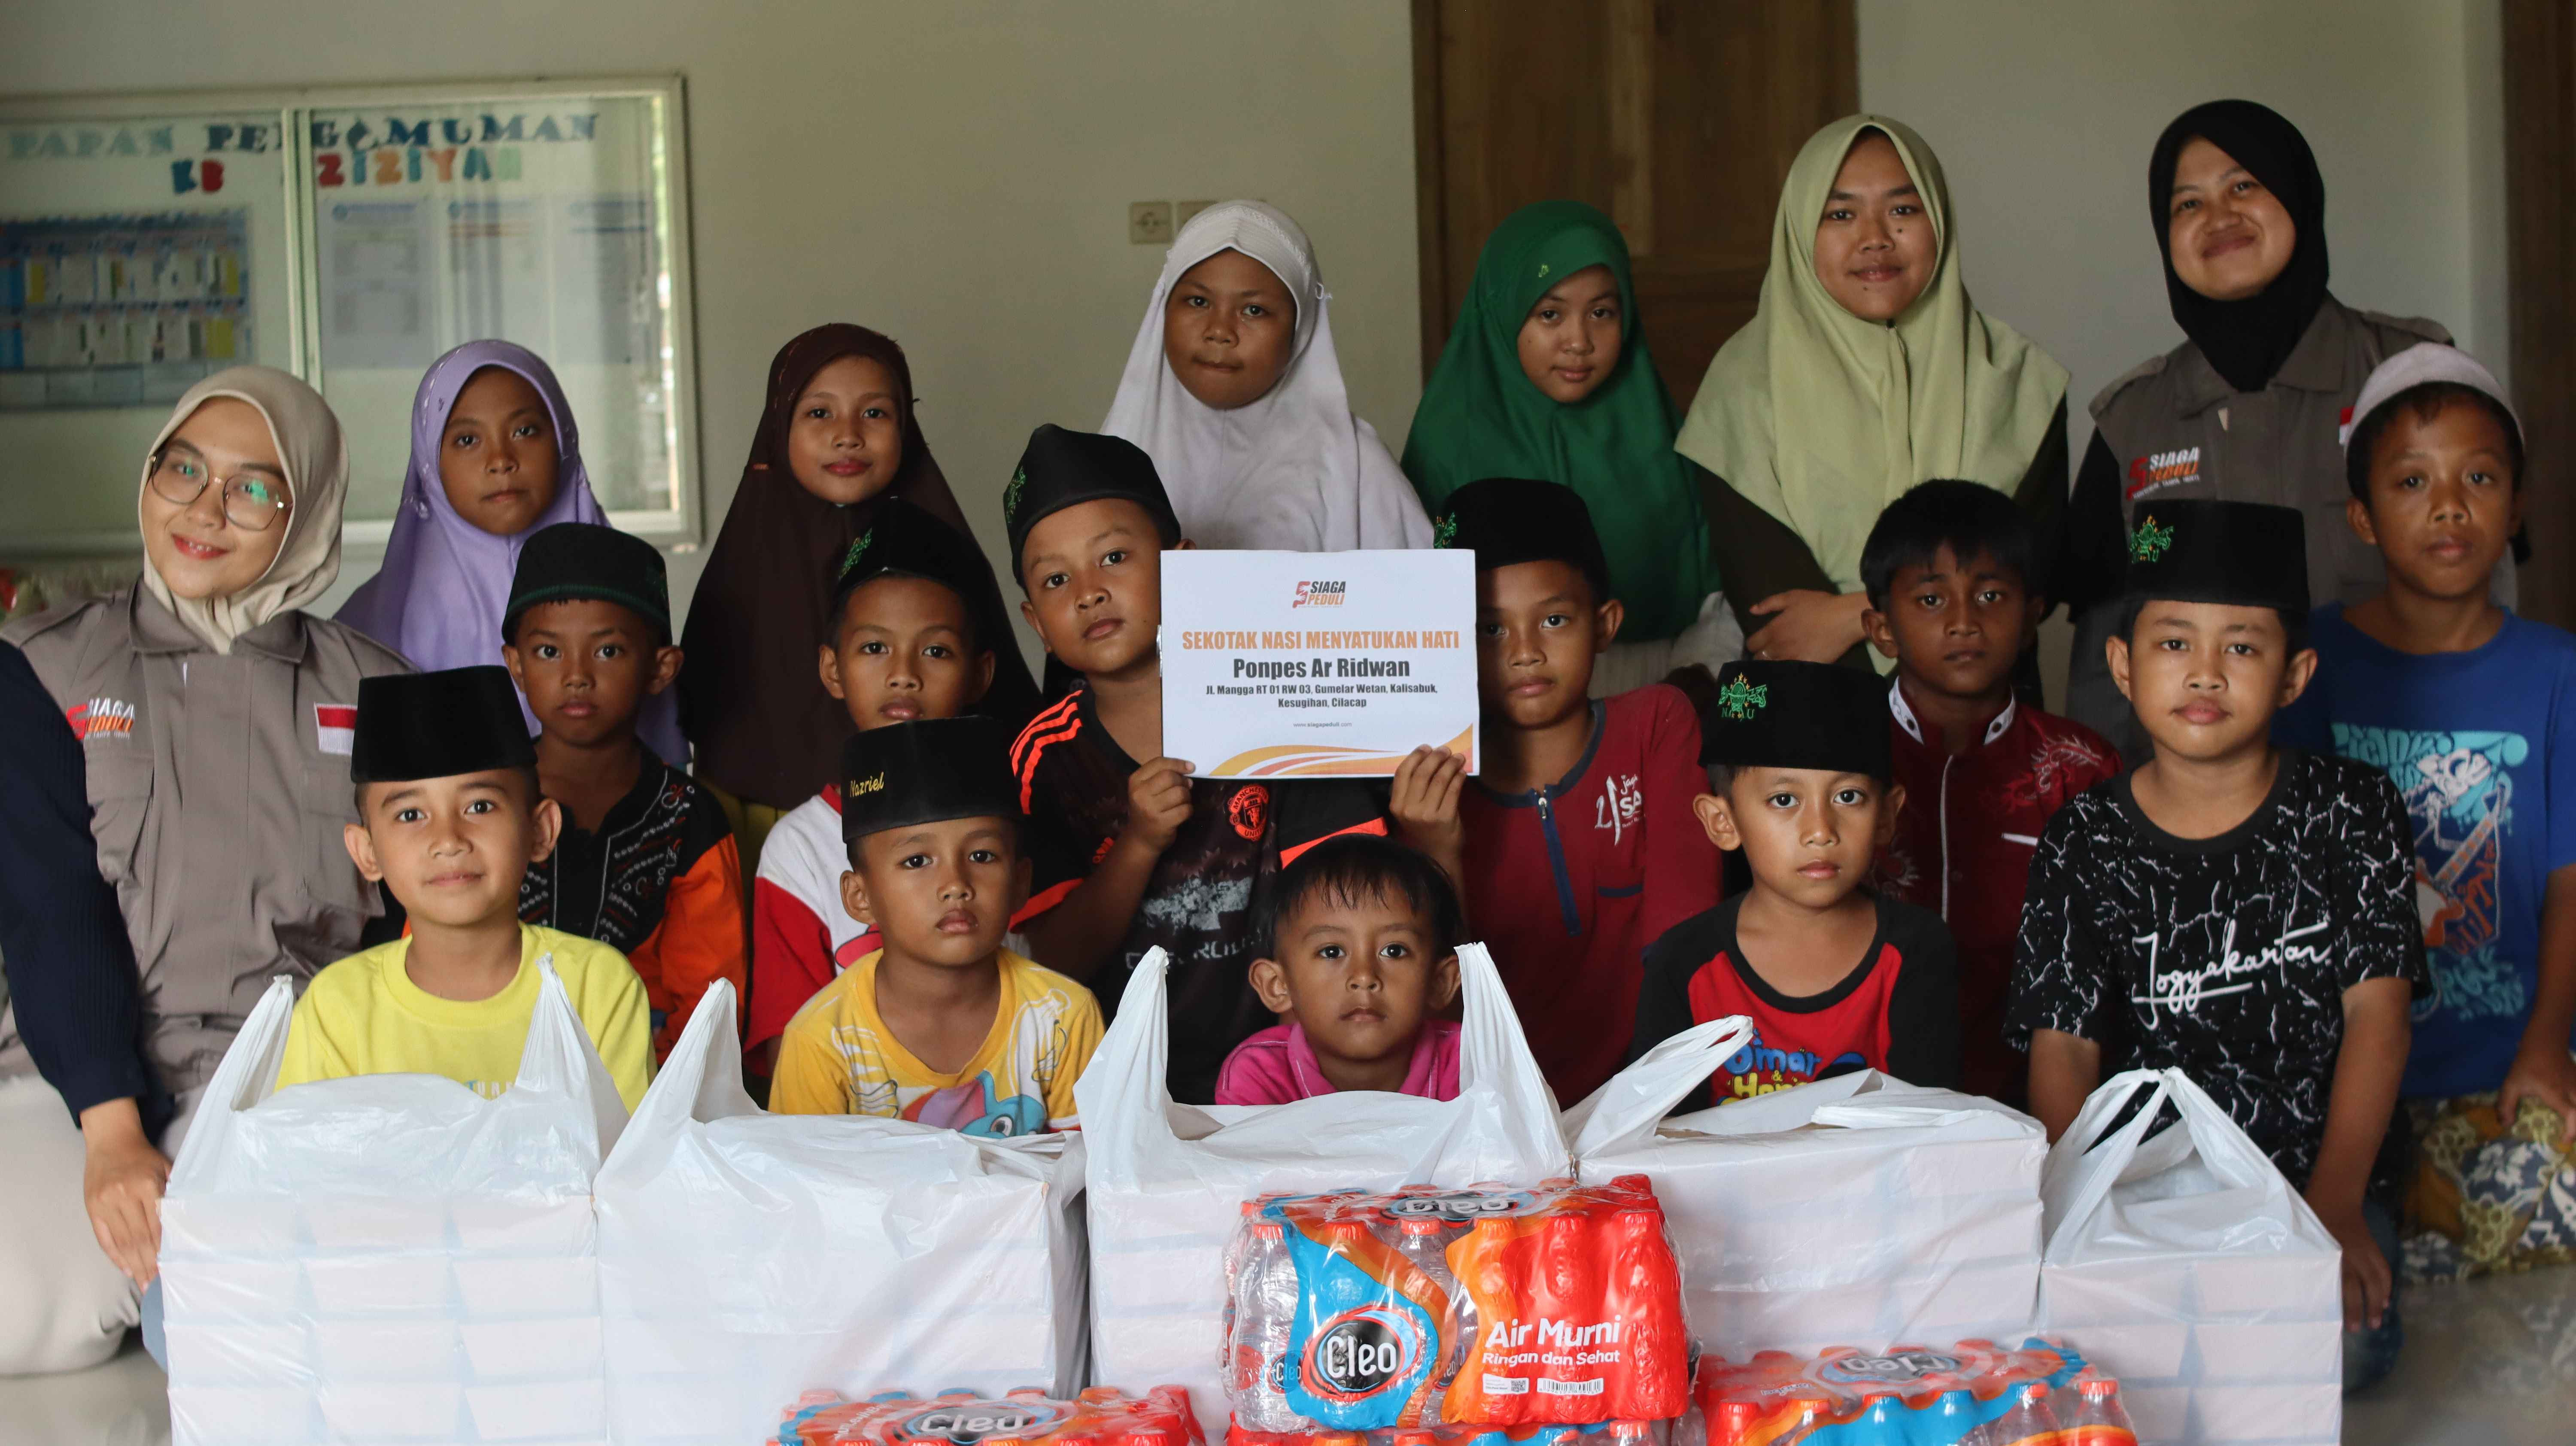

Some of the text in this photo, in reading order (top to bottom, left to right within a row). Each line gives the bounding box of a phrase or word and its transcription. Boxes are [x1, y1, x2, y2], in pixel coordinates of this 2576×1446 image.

[9, 125, 175, 158] PAPAN
[171, 158, 225, 195] KB
[2149, 446, 2200, 470] SIAGA
[1310, 581, 1346, 593] SIAGA
[1307, 594, 1345, 605] PEDULI
[1182, 631, 1459, 650] SEKOTAK NASI MENYATUKAN HATI
[1233, 658, 1410, 680] Ponpes Ar Ridwan
[1206, 684, 1438, 696] Jl. Mangga RT 01 RW 03, Gumelar Wetan, Kalisabuk,
[1278, 697, 1367, 708] Kesugihan, Cilacap
[850, 772, 884, 797] Nazriel
[1724, 1042, 1822, 1077] Omar
[1405, 1199, 1510, 1221] Cleo
[1485, 1315, 1621, 1348] Air Murni
[1327, 1335, 1397, 1378] Cleo
[1482, 1349, 1621, 1367] Ringan dan Sehat
[1276, 1362, 1302, 1381] Cleo
[920, 1413, 1024, 1433] Cleo
